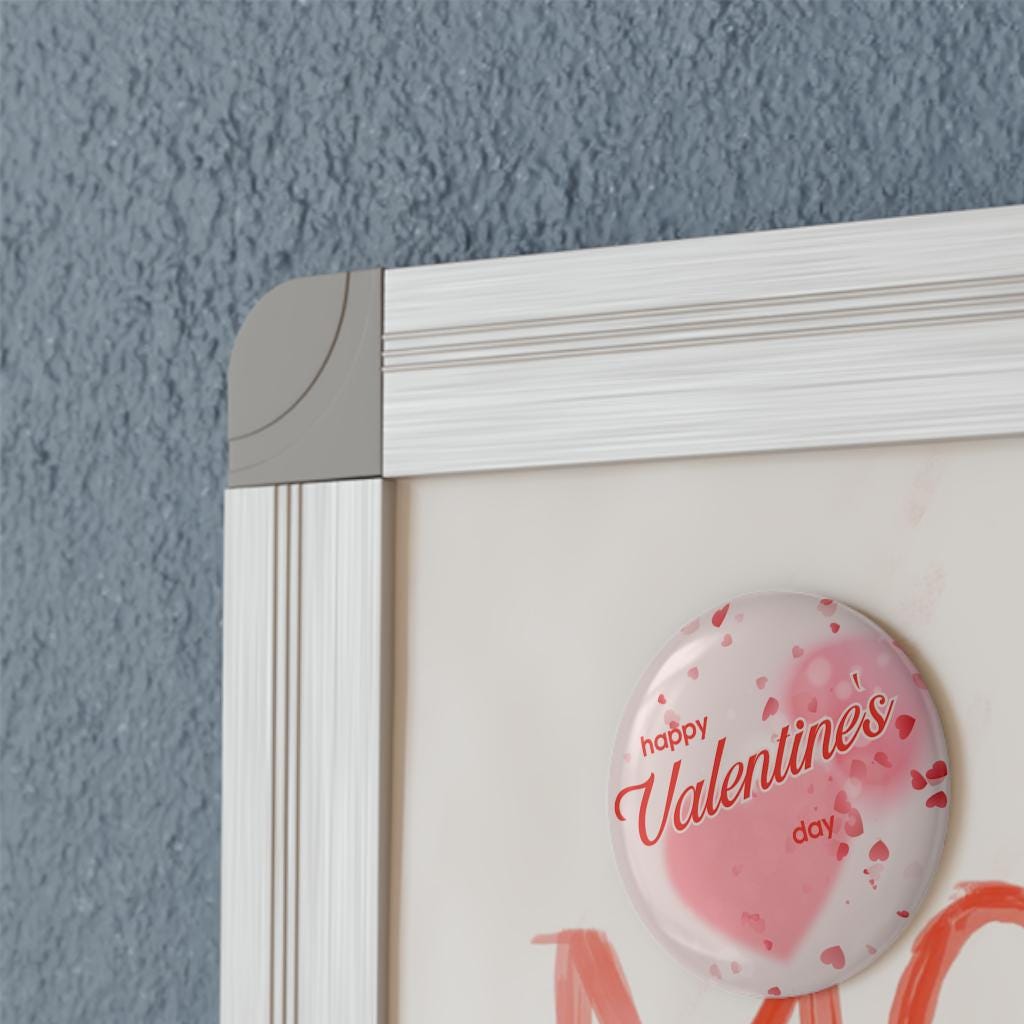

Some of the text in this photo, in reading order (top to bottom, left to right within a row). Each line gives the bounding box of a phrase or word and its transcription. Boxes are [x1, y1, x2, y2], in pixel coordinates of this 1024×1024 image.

[639, 715, 709, 758] happy
[613, 671, 897, 849] Valentine's
[791, 814, 836, 846] day
